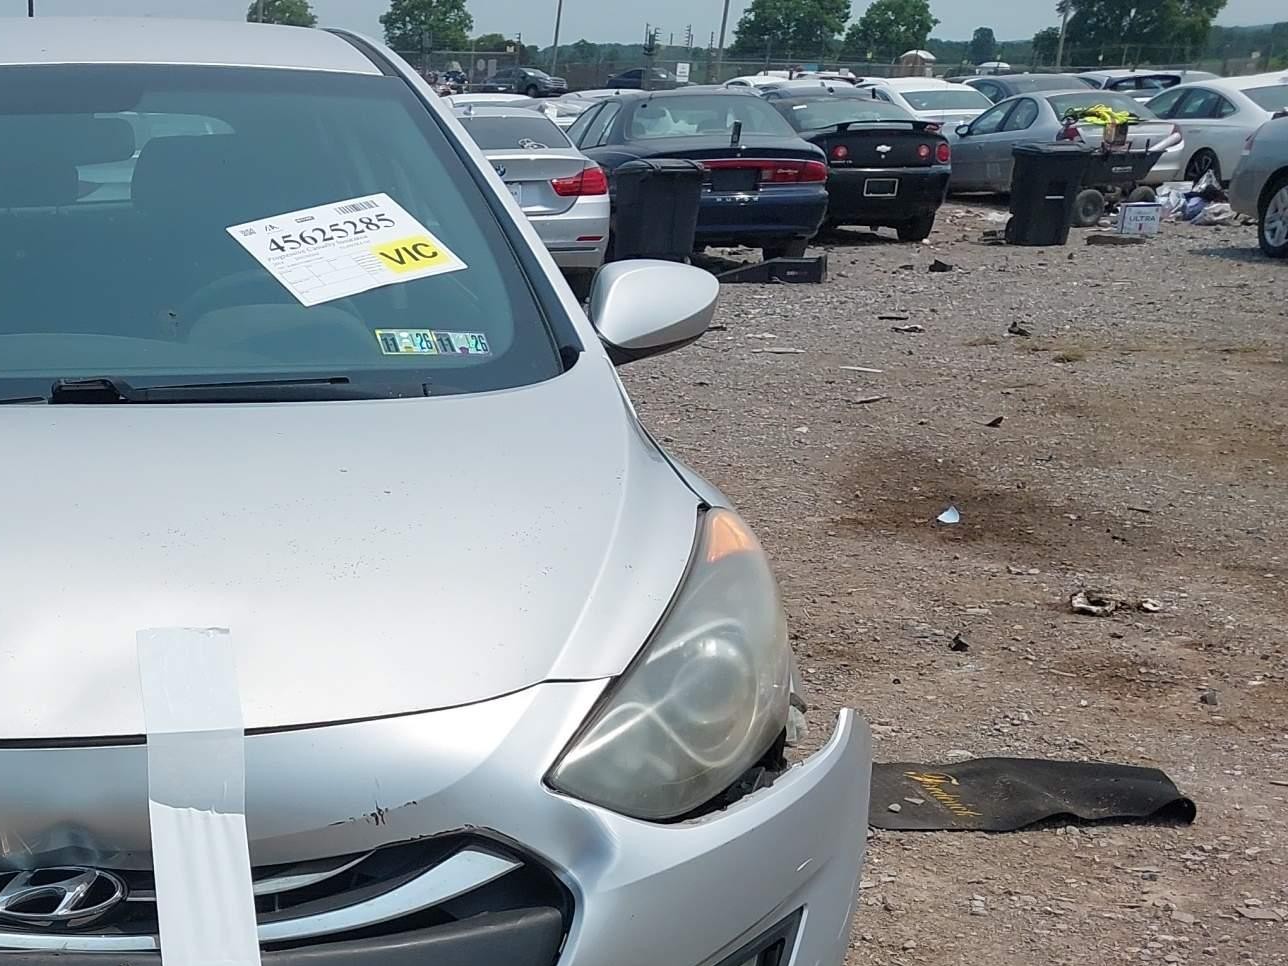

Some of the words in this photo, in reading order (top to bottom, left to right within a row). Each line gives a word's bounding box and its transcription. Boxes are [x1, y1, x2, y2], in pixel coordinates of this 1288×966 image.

[269, 213, 395, 252] 45625285
[379, 242, 438, 265] VIC
[416, 332, 434, 350] 26
[471, 334, 489, 352] 26
